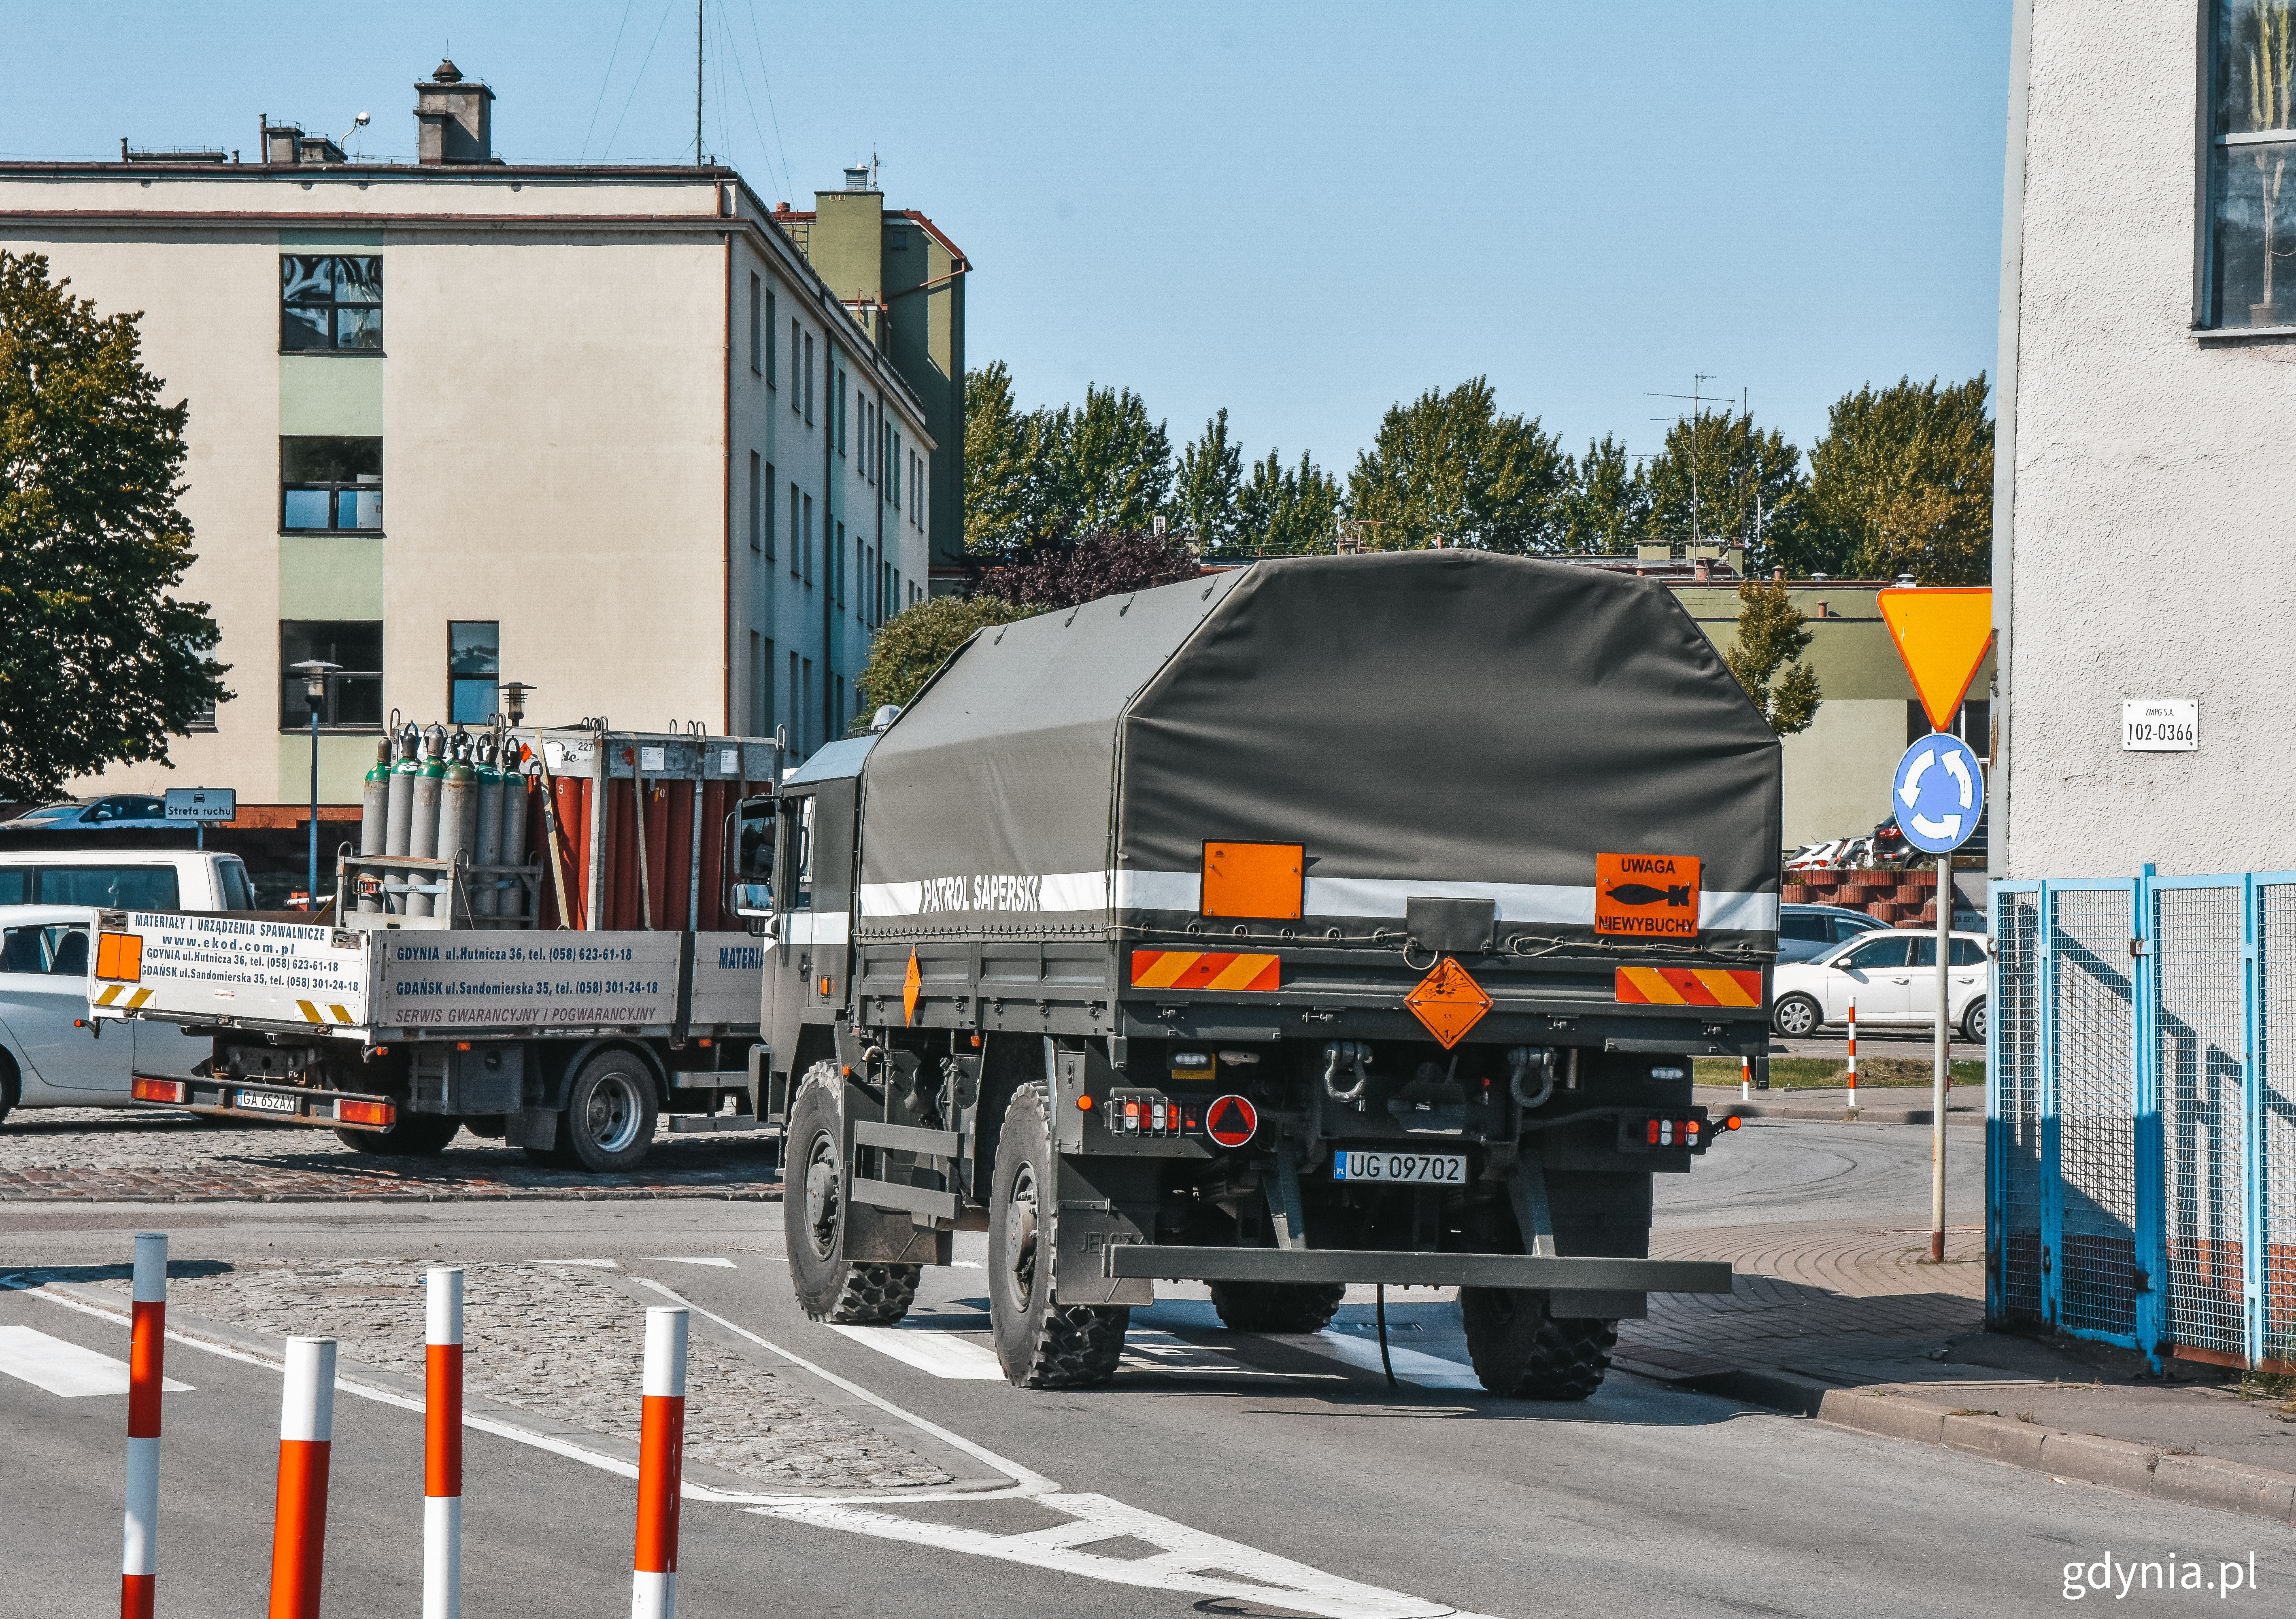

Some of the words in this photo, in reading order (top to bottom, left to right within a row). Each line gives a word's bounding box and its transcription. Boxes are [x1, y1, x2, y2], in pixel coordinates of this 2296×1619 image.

[2145, 708, 2162, 716] ZMPG
[2164, 708, 2175, 716] S.A.
[2128, 723, 2192, 741] 102-0366
[558, 784, 564, 795] 5
[168, 806, 198, 815] Strefa
[203, 806, 231, 815] ruchu
[1621, 858, 1675, 874] UWAGA
[922, 875, 970, 914] PATROL
[973, 874, 1039, 912] SAPERSKI
[135, 914, 185, 929] MATERIAŁY
[190, 918, 193, 930] I
[198, 919, 255, 935] URZĄDZENIA
[260, 924, 325, 941] SPAWALNICZE
[1598, 916, 1695, 933] NIEWYBUCHY
[162, 936, 295, 957] www.ekod.com.pl
[397, 947, 440, 960] GDYNIA
[446, 947, 506, 960] ul.Hutnicza
[509, 947, 525, 962] 36,
[529, 947, 546, 960] tel.
[549, 948, 576, 962] (058)
[579, 948, 632, 961] 623-61-18
[147, 948, 180, 960] GDYNIA
[183, 951, 231, 964] ul.Hutnicza
[250, 956, 264, 967] tel.
[267, 957, 289, 971] (058)
[293, 959, 338, 972] 623-61-18
[142, 963, 177, 977] GDAŃSK
[180, 968, 251, 983] ul.Sandomierska
[253, 973, 267, 986] 35,
[270, 975, 284, 986] tel.
[287, 975, 310, 989] (058)
[313, 978, 359, 992] 301-24-18
[396, 977, 443, 995] GDAŃSK
[445, 981, 534, 995] ul.Sandomierska
[536, 981, 553, 996] 35,
[555, 981, 572, 994] tel.
[576, 981, 603, 996] (058)
[605, 981, 658, 994] 301-24-18
[396, 1009, 442, 1023] SERWIS
[448, 1007, 540, 1023] GWARANCYJNY
[543, 1008, 548, 1022] I
[552, 1007, 656, 1022] POGWARANCYJNY
[1444, 1029, 1450, 1038] 1
[244, 1091, 257, 1106] GA
[261, 1093, 293, 1110] 652AX
[1351, 1154, 1380, 1178] UG
[1389, 1156, 1459, 1181] 09702
